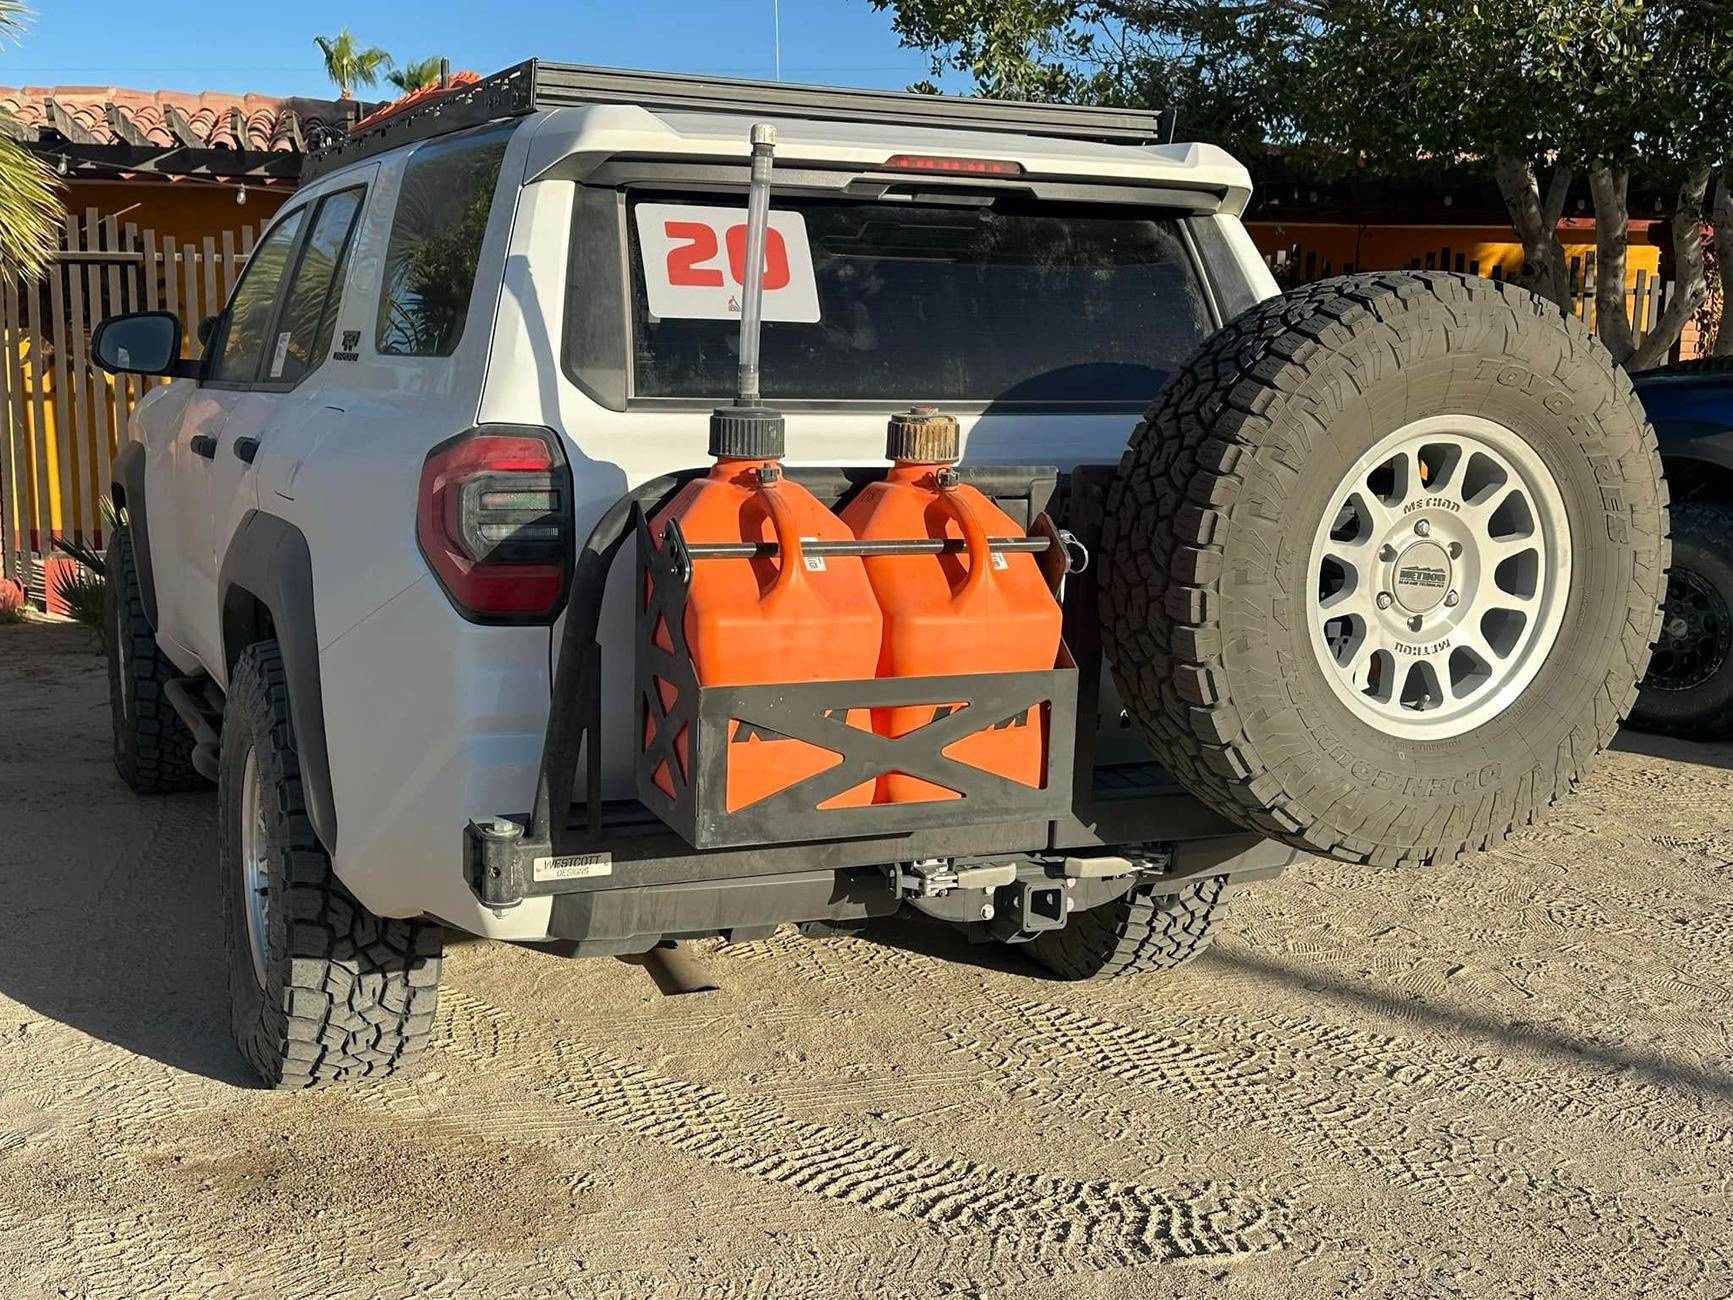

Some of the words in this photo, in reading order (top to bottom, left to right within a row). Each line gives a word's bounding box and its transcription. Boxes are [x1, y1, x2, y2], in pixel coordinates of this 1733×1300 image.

[665, 221, 790, 290] 20
[1473, 358, 1573, 416] TOYO
[1567, 415, 1630, 545] TIRES
[1403, 498, 1461, 514] METHOD
[1400, 570, 1446, 581] METHOD
[1394, 639, 1451, 656] METHOD
[1402, 757, 1504, 799] OPEN
[544, 855, 602, 870] WESTCOTT
[556, 867, 590, 877] DESIGNS
